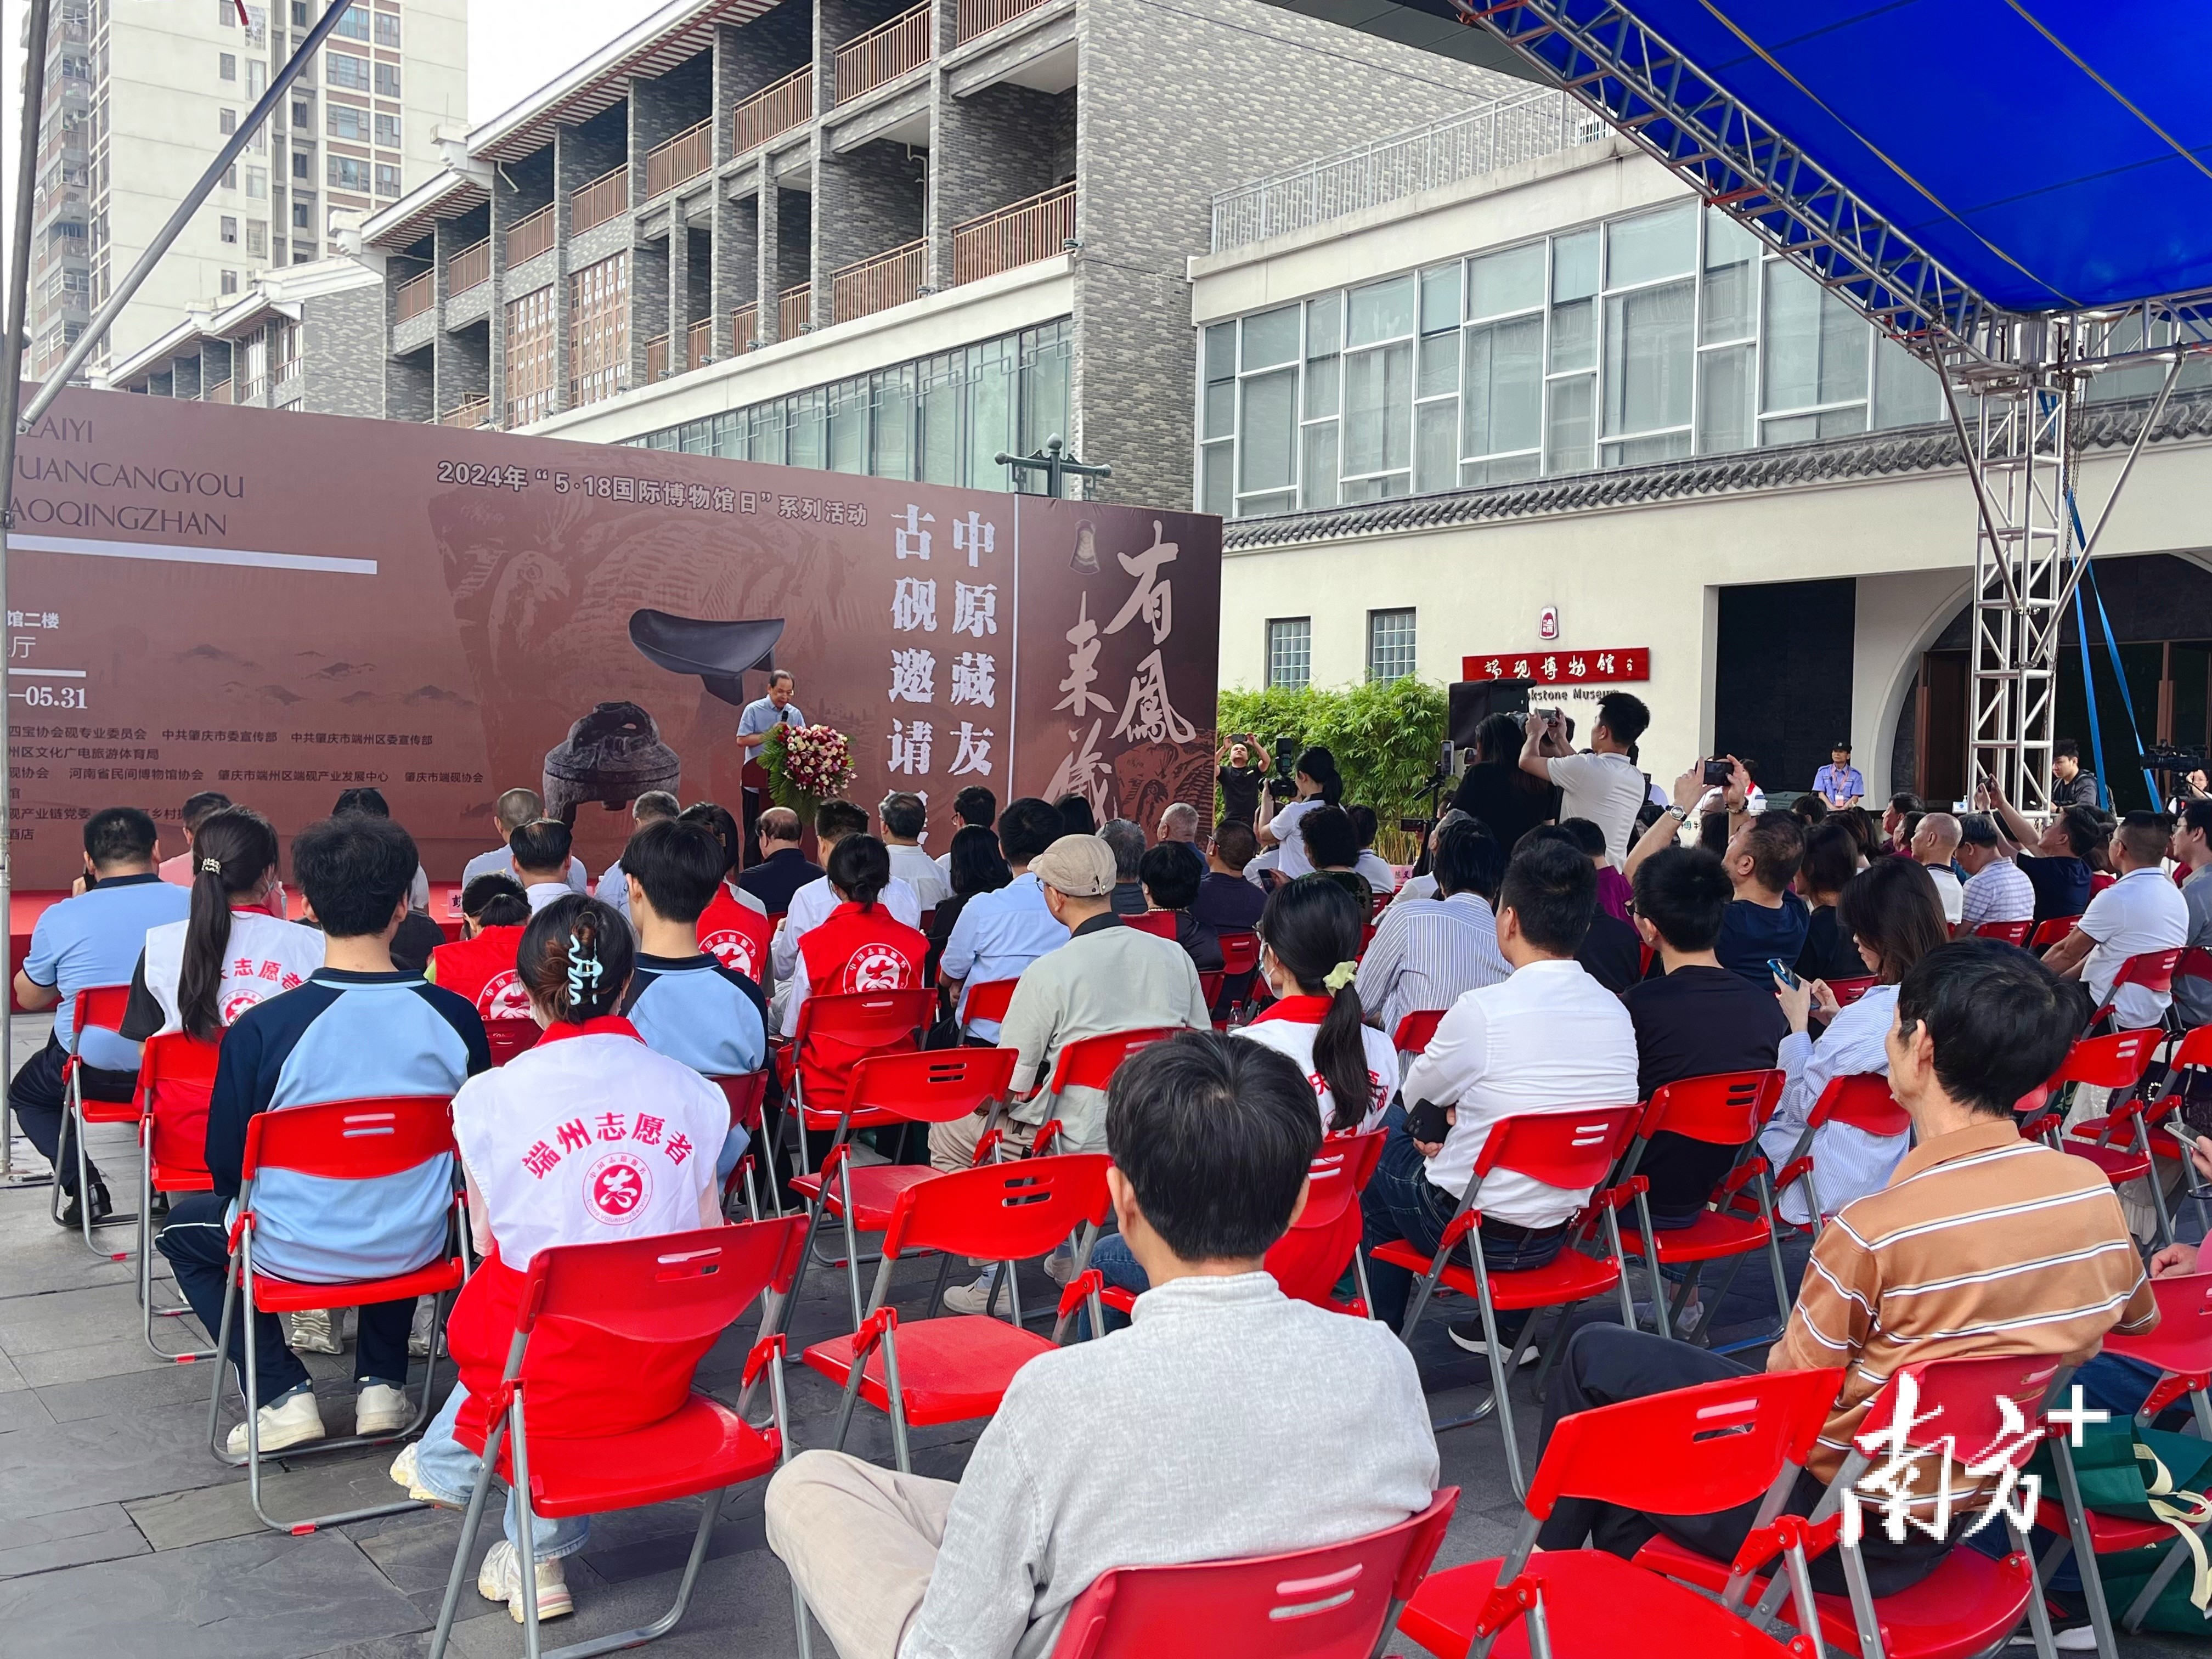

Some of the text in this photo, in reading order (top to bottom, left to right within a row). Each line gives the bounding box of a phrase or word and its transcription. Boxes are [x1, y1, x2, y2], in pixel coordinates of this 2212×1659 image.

[14, 455, 243, 498] UANCANGYOU
[948, 511, 997, 776] 中原藏友
[887, 503, 938, 845] 古砚邀请
[1527, 689, 1567, 701] kstone
[69, 768, 204, 781] 河南省民间博物馆协会
[405, 772, 483, 783] 肇庆市端砚协会
[522, 1112, 693, 1180] 端州志愿者
